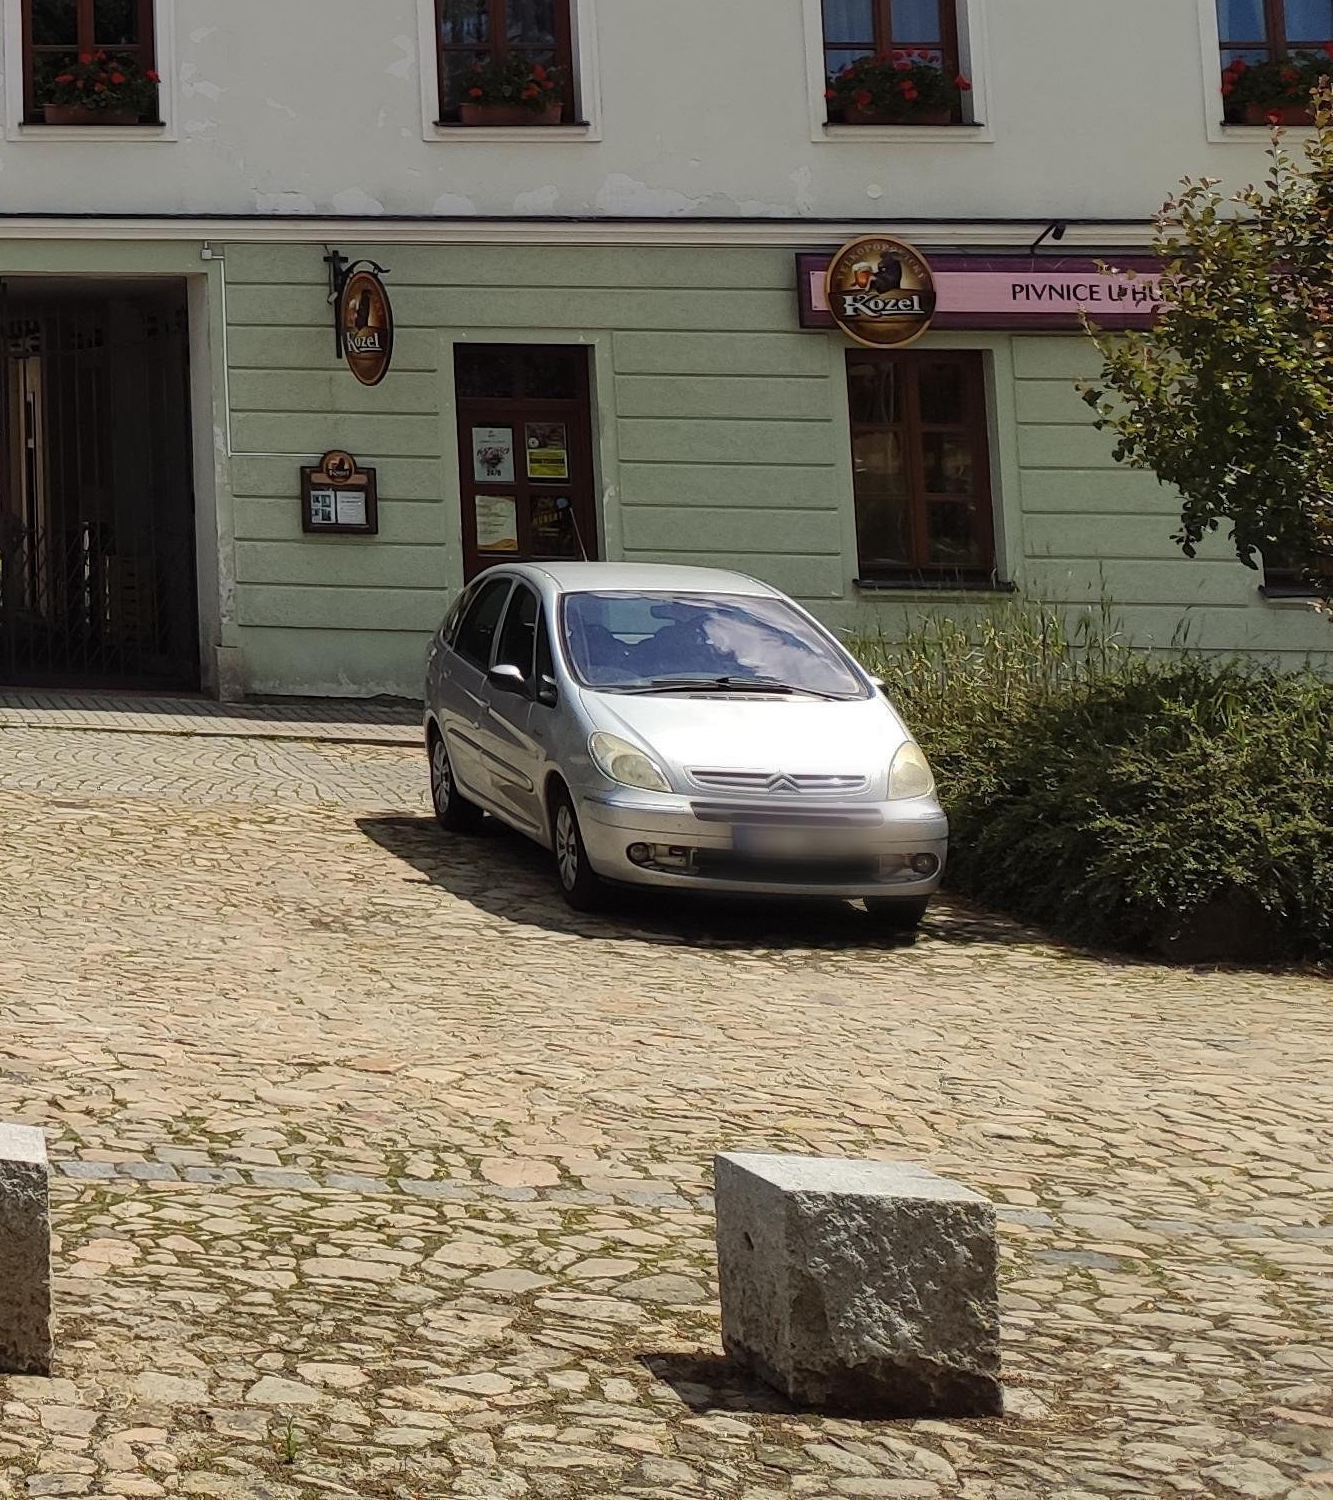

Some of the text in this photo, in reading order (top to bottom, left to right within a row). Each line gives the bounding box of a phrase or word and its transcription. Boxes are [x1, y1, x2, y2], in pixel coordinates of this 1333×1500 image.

[1011, 283, 1102, 302] PIVNICE
[842, 294, 925, 316] Kozel
[346, 331, 383, 353] Kozel
